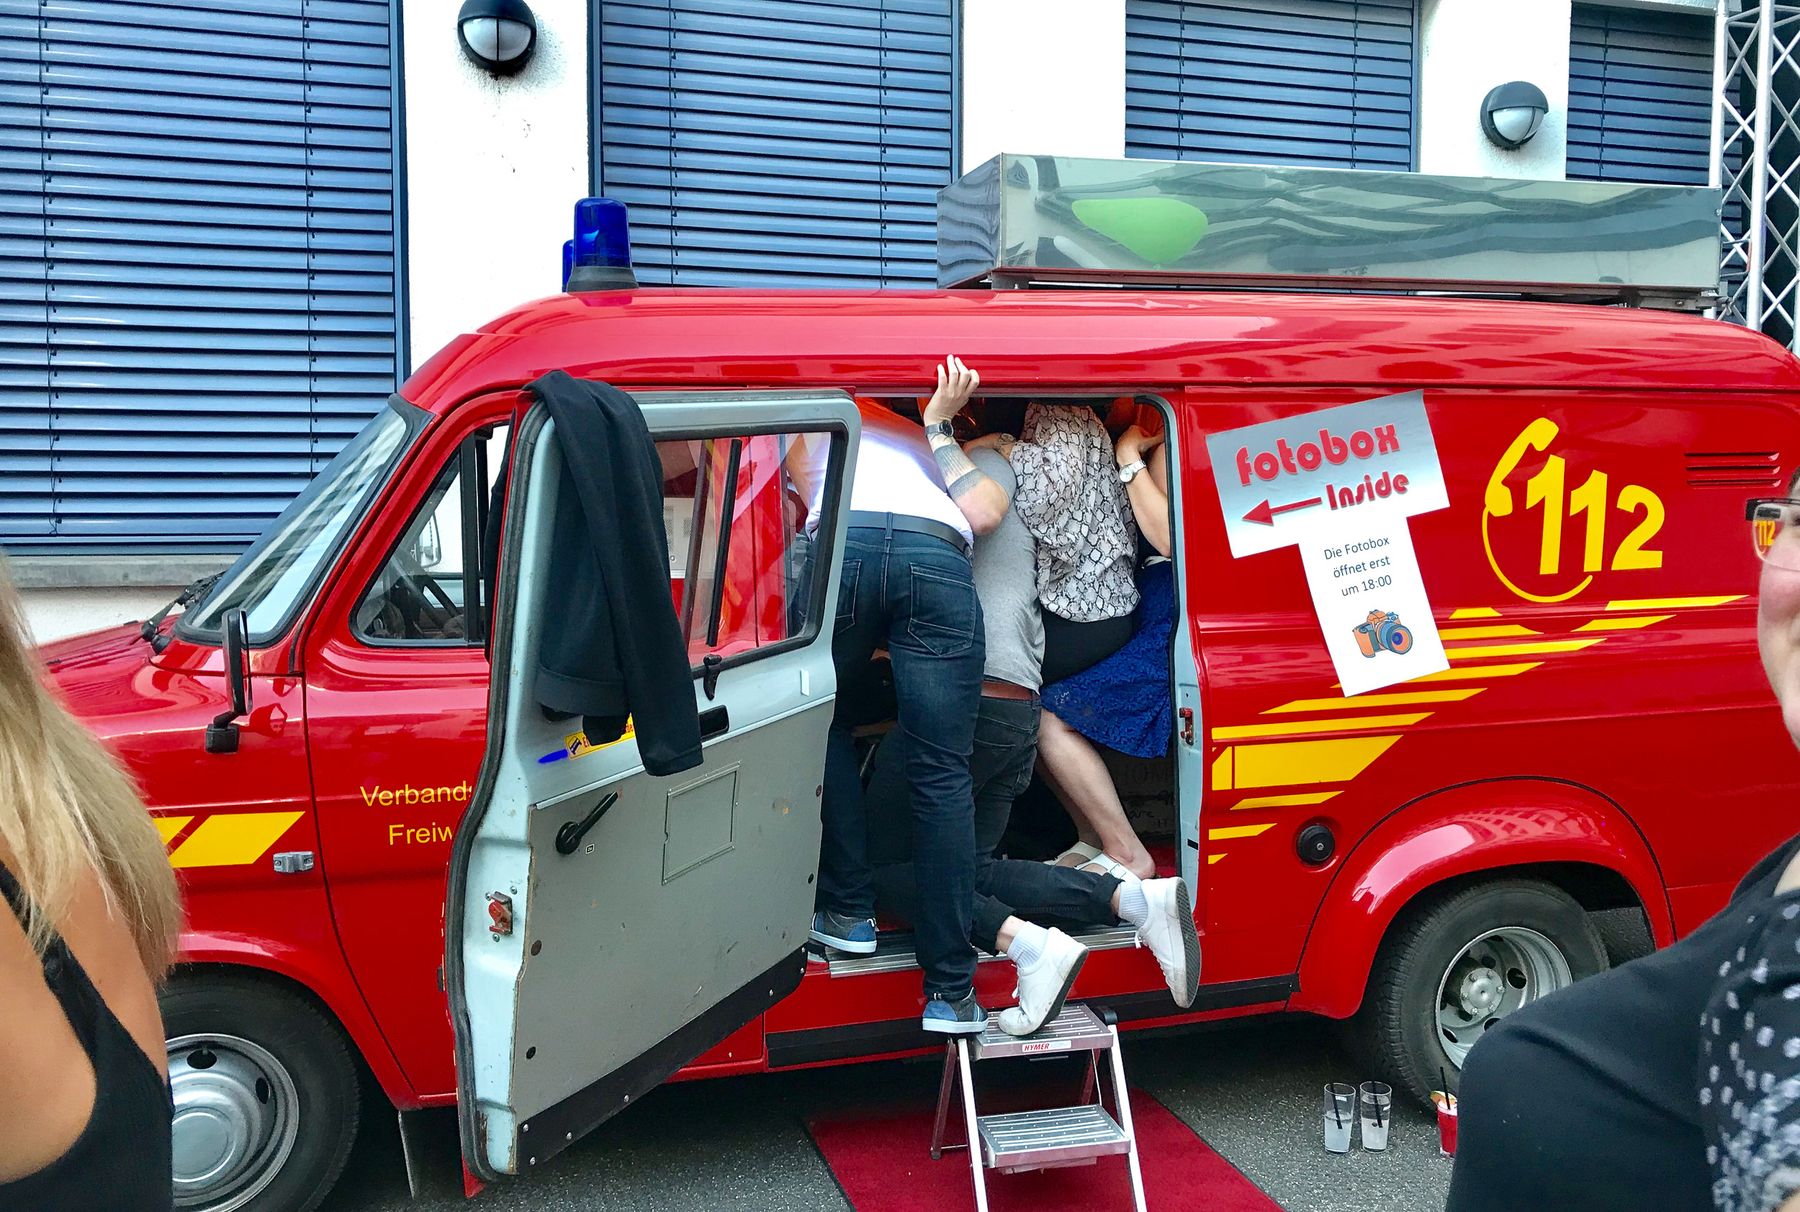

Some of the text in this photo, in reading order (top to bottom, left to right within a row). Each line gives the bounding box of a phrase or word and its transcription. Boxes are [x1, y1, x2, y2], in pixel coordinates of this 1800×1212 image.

[1236, 424, 1400, 486] fotobox
[1326, 471, 1409, 510] Inside
[1526, 454, 1665, 575] 112
[1324, 537, 1390, 560] Die Fotobox
[1333, 556, 1391, 578] öffnet erst
[1341, 574, 1392, 597] um 18:00
[360, 780, 472, 807] Verband
